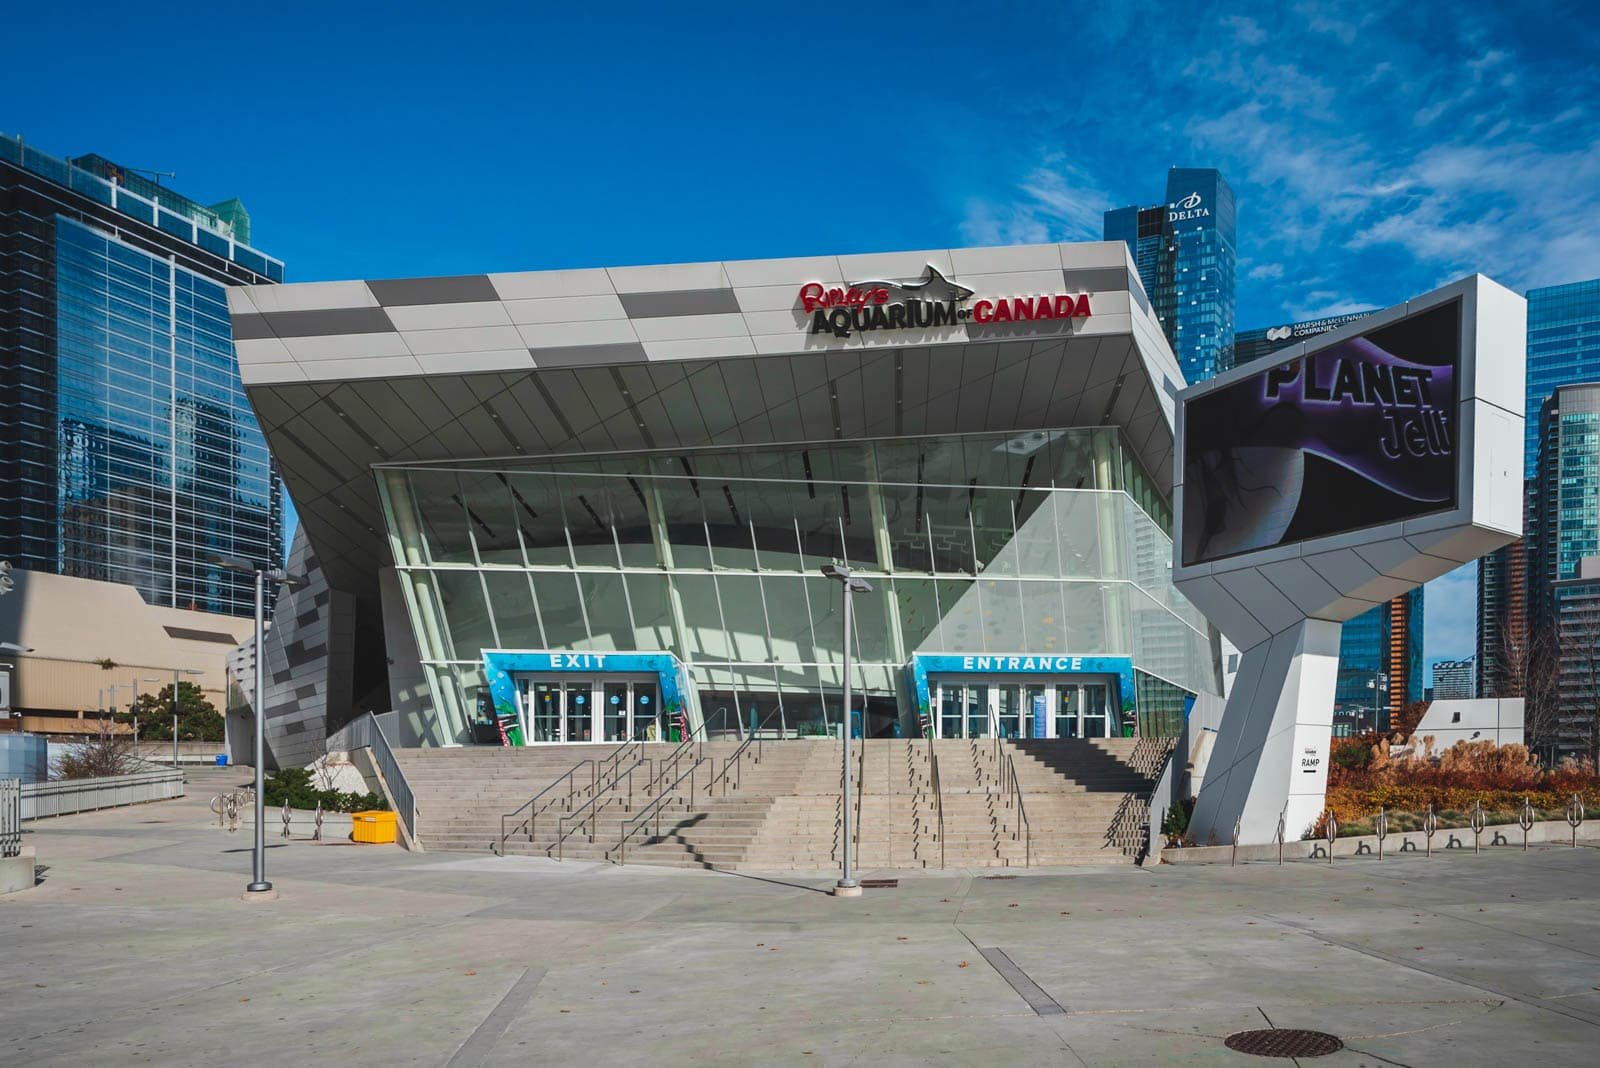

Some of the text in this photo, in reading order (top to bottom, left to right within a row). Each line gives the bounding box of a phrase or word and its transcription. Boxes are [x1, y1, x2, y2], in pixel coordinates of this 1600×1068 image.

[1168, 209, 1210, 222] DELTA
[812, 294, 1093, 338] AQUARIUM OF CANADA
[1294, 321, 1320, 330] MARSH
[1294, 325, 1338, 336] COMPANIES
[1263, 355, 1433, 407] PLANET
[550, 654, 606, 668] EXIT
[963, 656, 1082, 670] ENTRANCE
[1301, 758, 1320, 767] RAMP
